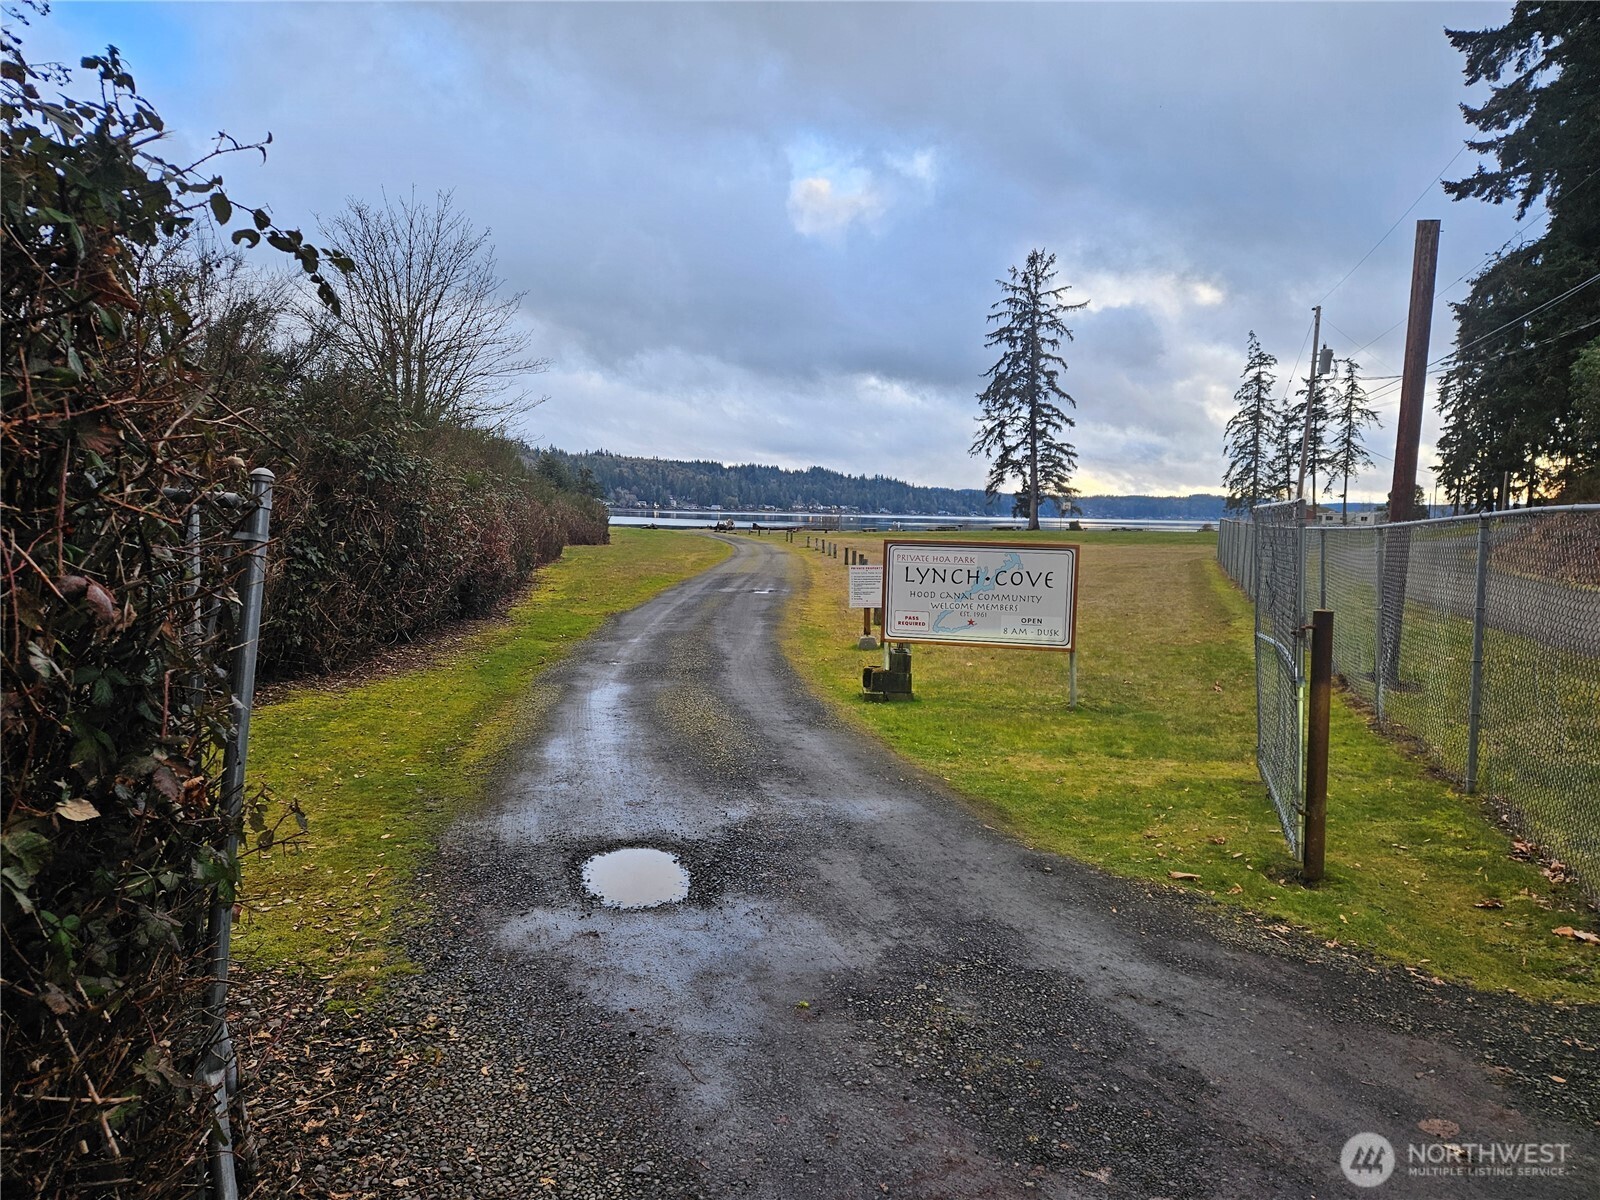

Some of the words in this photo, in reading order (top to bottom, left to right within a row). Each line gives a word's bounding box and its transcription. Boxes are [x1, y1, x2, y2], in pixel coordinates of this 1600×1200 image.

[897, 554, 930, 562] PRIVATE
[905, 566, 980, 585] LYNCH
[995, 570, 1054, 588] COVE
[940, 592, 974, 600] CANAL
[978, 593, 1042, 603] COMMUNITY
[931, 602, 974, 610] WELCOME
[977, 603, 1018, 611] MEMBERS
